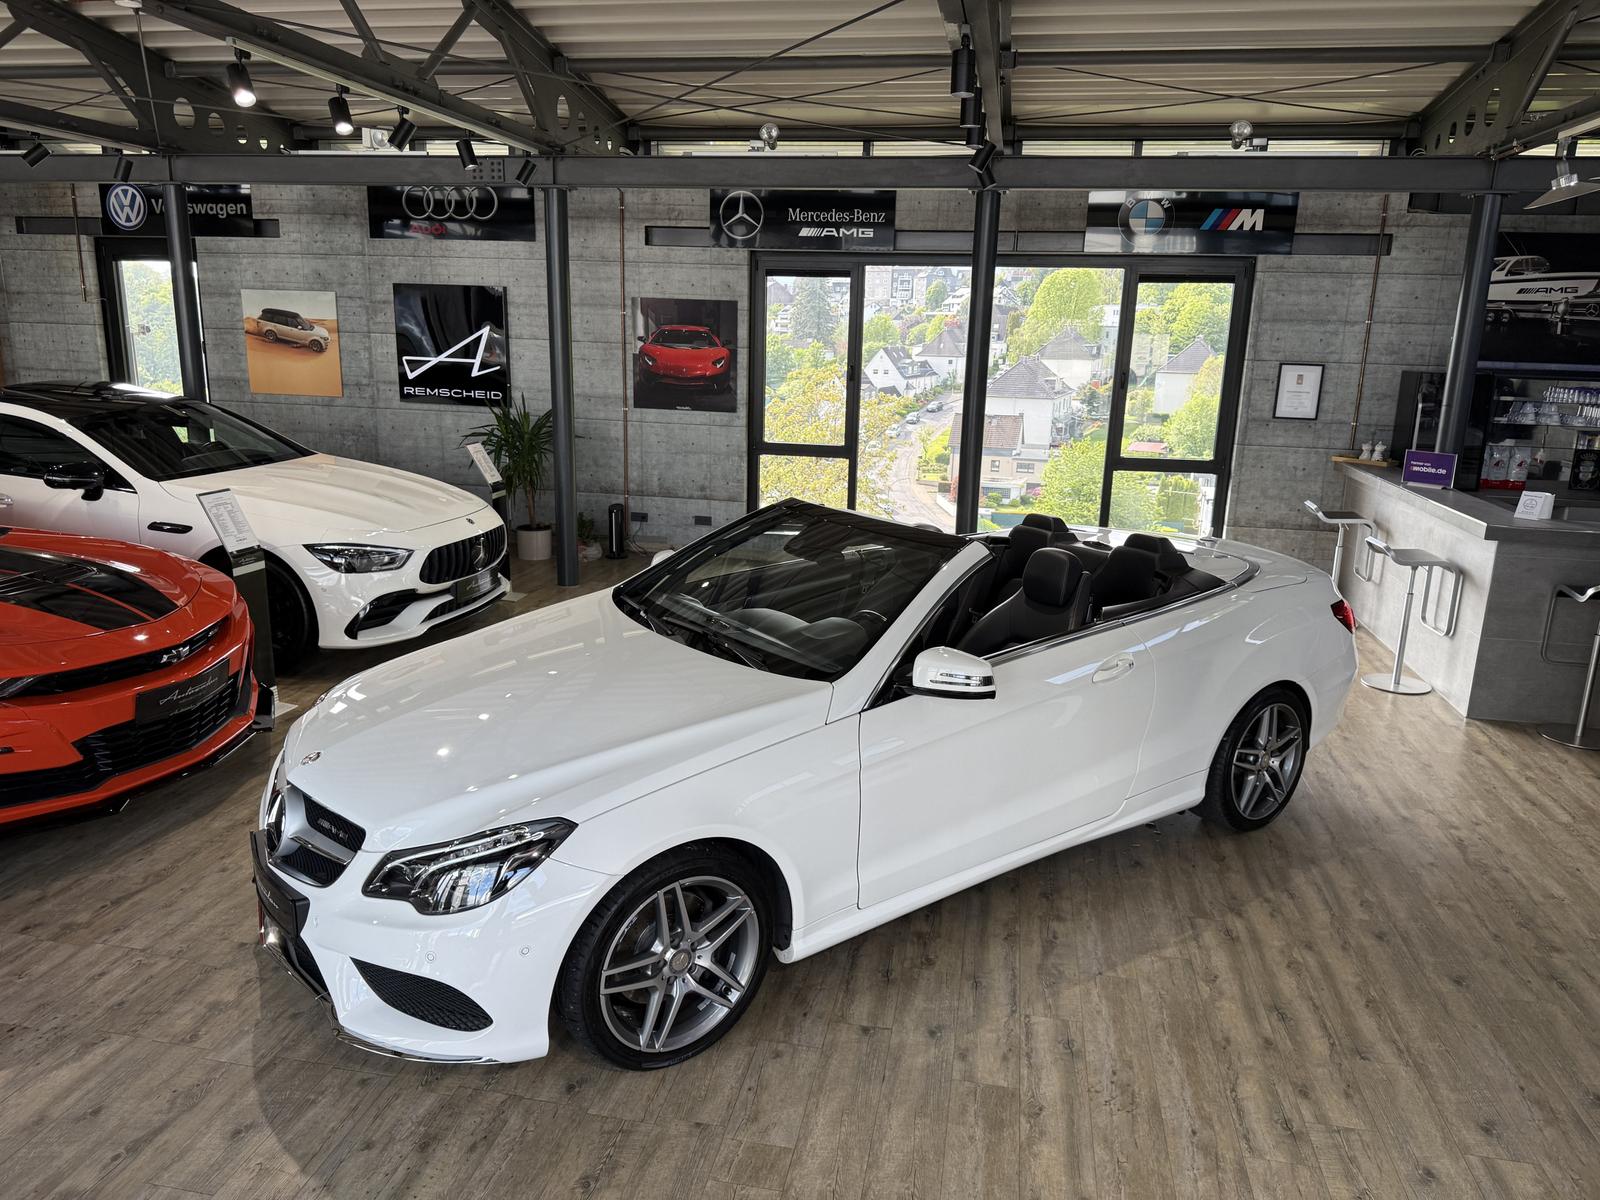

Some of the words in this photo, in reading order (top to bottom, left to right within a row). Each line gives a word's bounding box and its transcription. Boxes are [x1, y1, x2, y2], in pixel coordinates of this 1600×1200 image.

[151, 198, 247, 218] Vswagen
[787, 207, 886, 223] Mercedes-Benz
[820, 227, 874, 238] AMG
[1533, 286, 1580, 295] AMG
[403, 386, 503, 400] REMSCHEID
[1411, 465, 1447, 475] mobile.de
